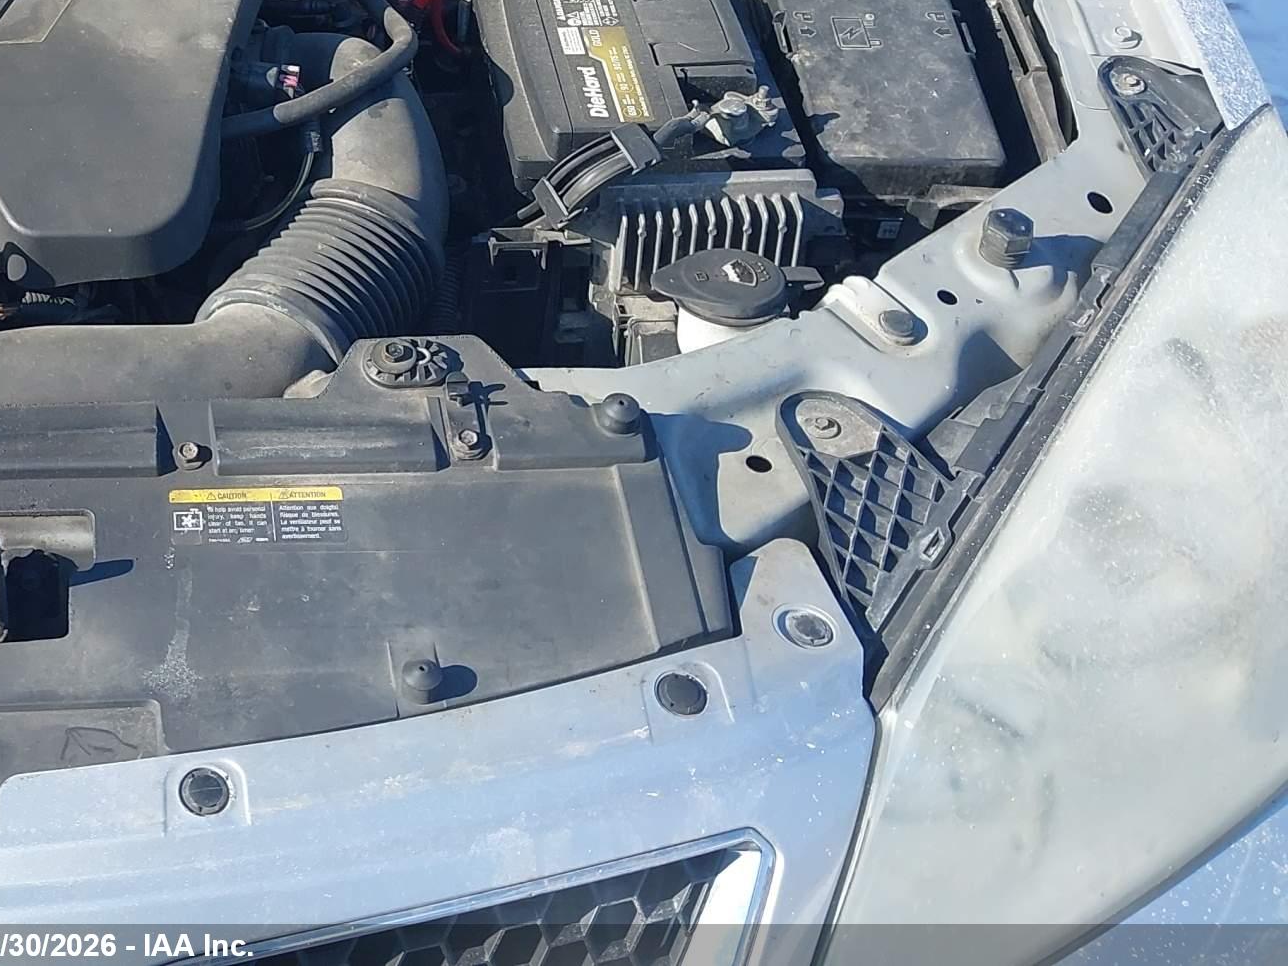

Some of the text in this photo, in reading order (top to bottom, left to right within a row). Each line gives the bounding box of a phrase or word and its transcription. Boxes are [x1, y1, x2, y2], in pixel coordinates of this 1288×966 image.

[588, 29, 602, 47] GOLD
[577, 66, 609, 118] DieHard
[627, 105, 637, 116] 650
[290, 490, 326, 498] ATTENTION
